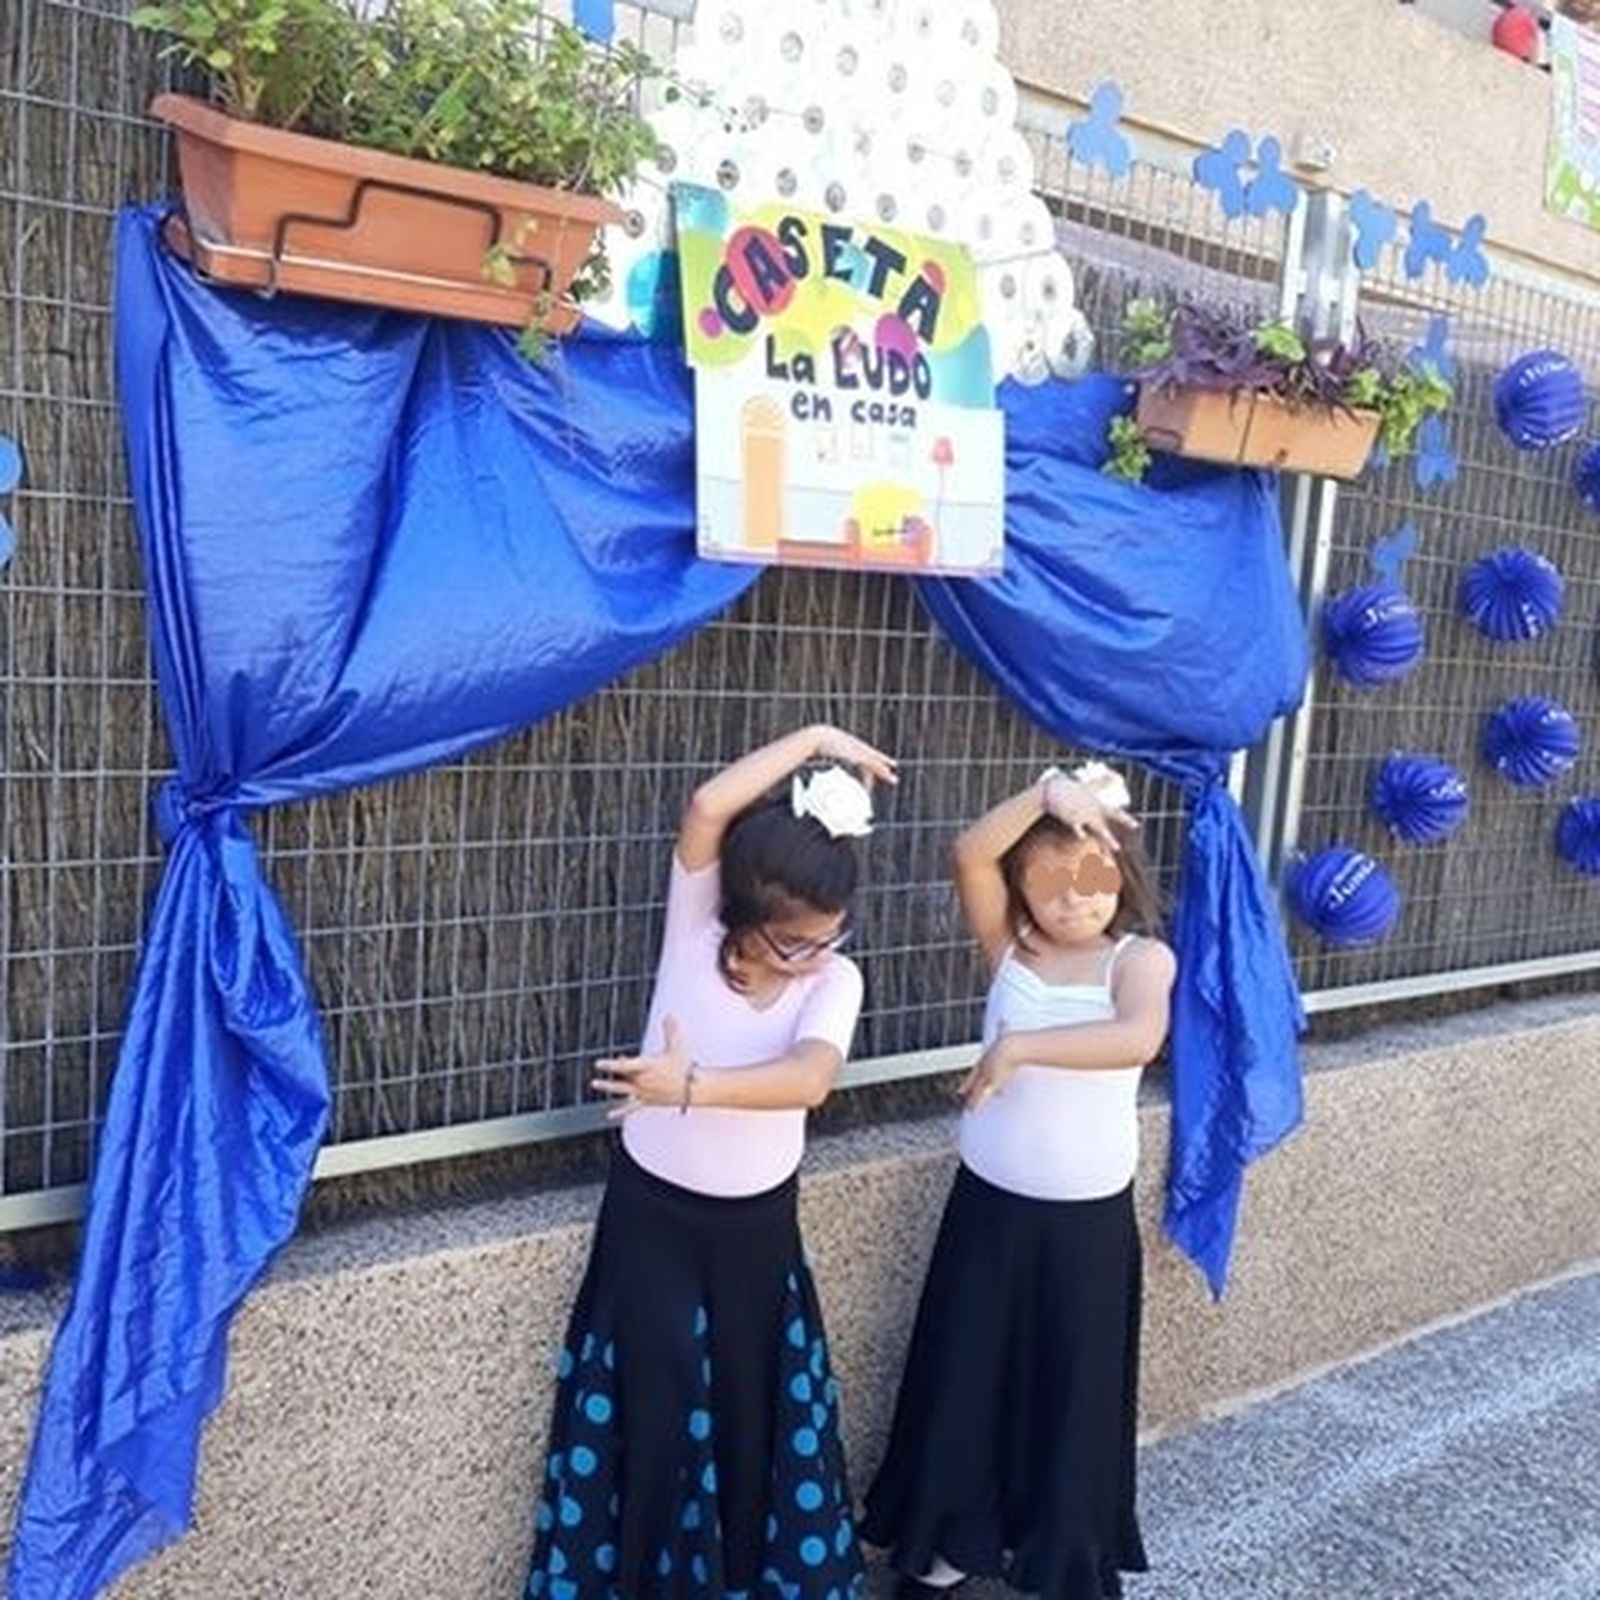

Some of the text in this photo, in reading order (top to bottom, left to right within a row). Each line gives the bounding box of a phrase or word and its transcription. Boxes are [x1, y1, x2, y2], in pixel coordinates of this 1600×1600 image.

[714, 216, 942, 345] CASETA
[766, 334, 932, 400] La LUDO
[791, 391, 916, 428] en casa
